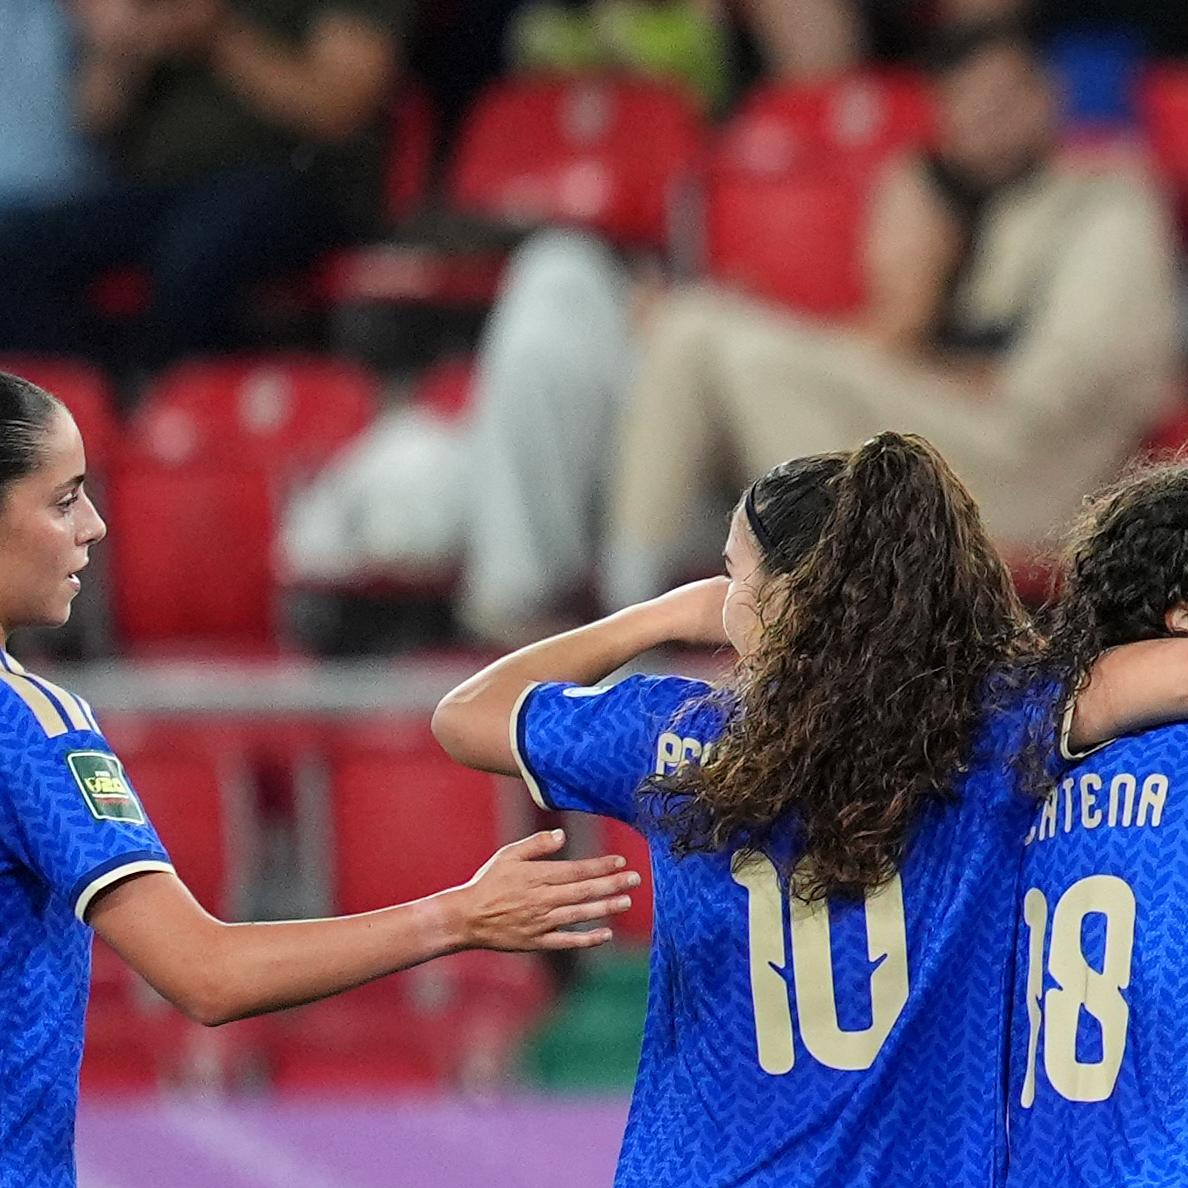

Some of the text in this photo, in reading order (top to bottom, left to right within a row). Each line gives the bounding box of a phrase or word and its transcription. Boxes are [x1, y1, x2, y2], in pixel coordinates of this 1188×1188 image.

[1024, 773, 1169, 846] ATENA
[730, 848, 910, 1076] 10
[1020, 874, 1137, 1109] 18
